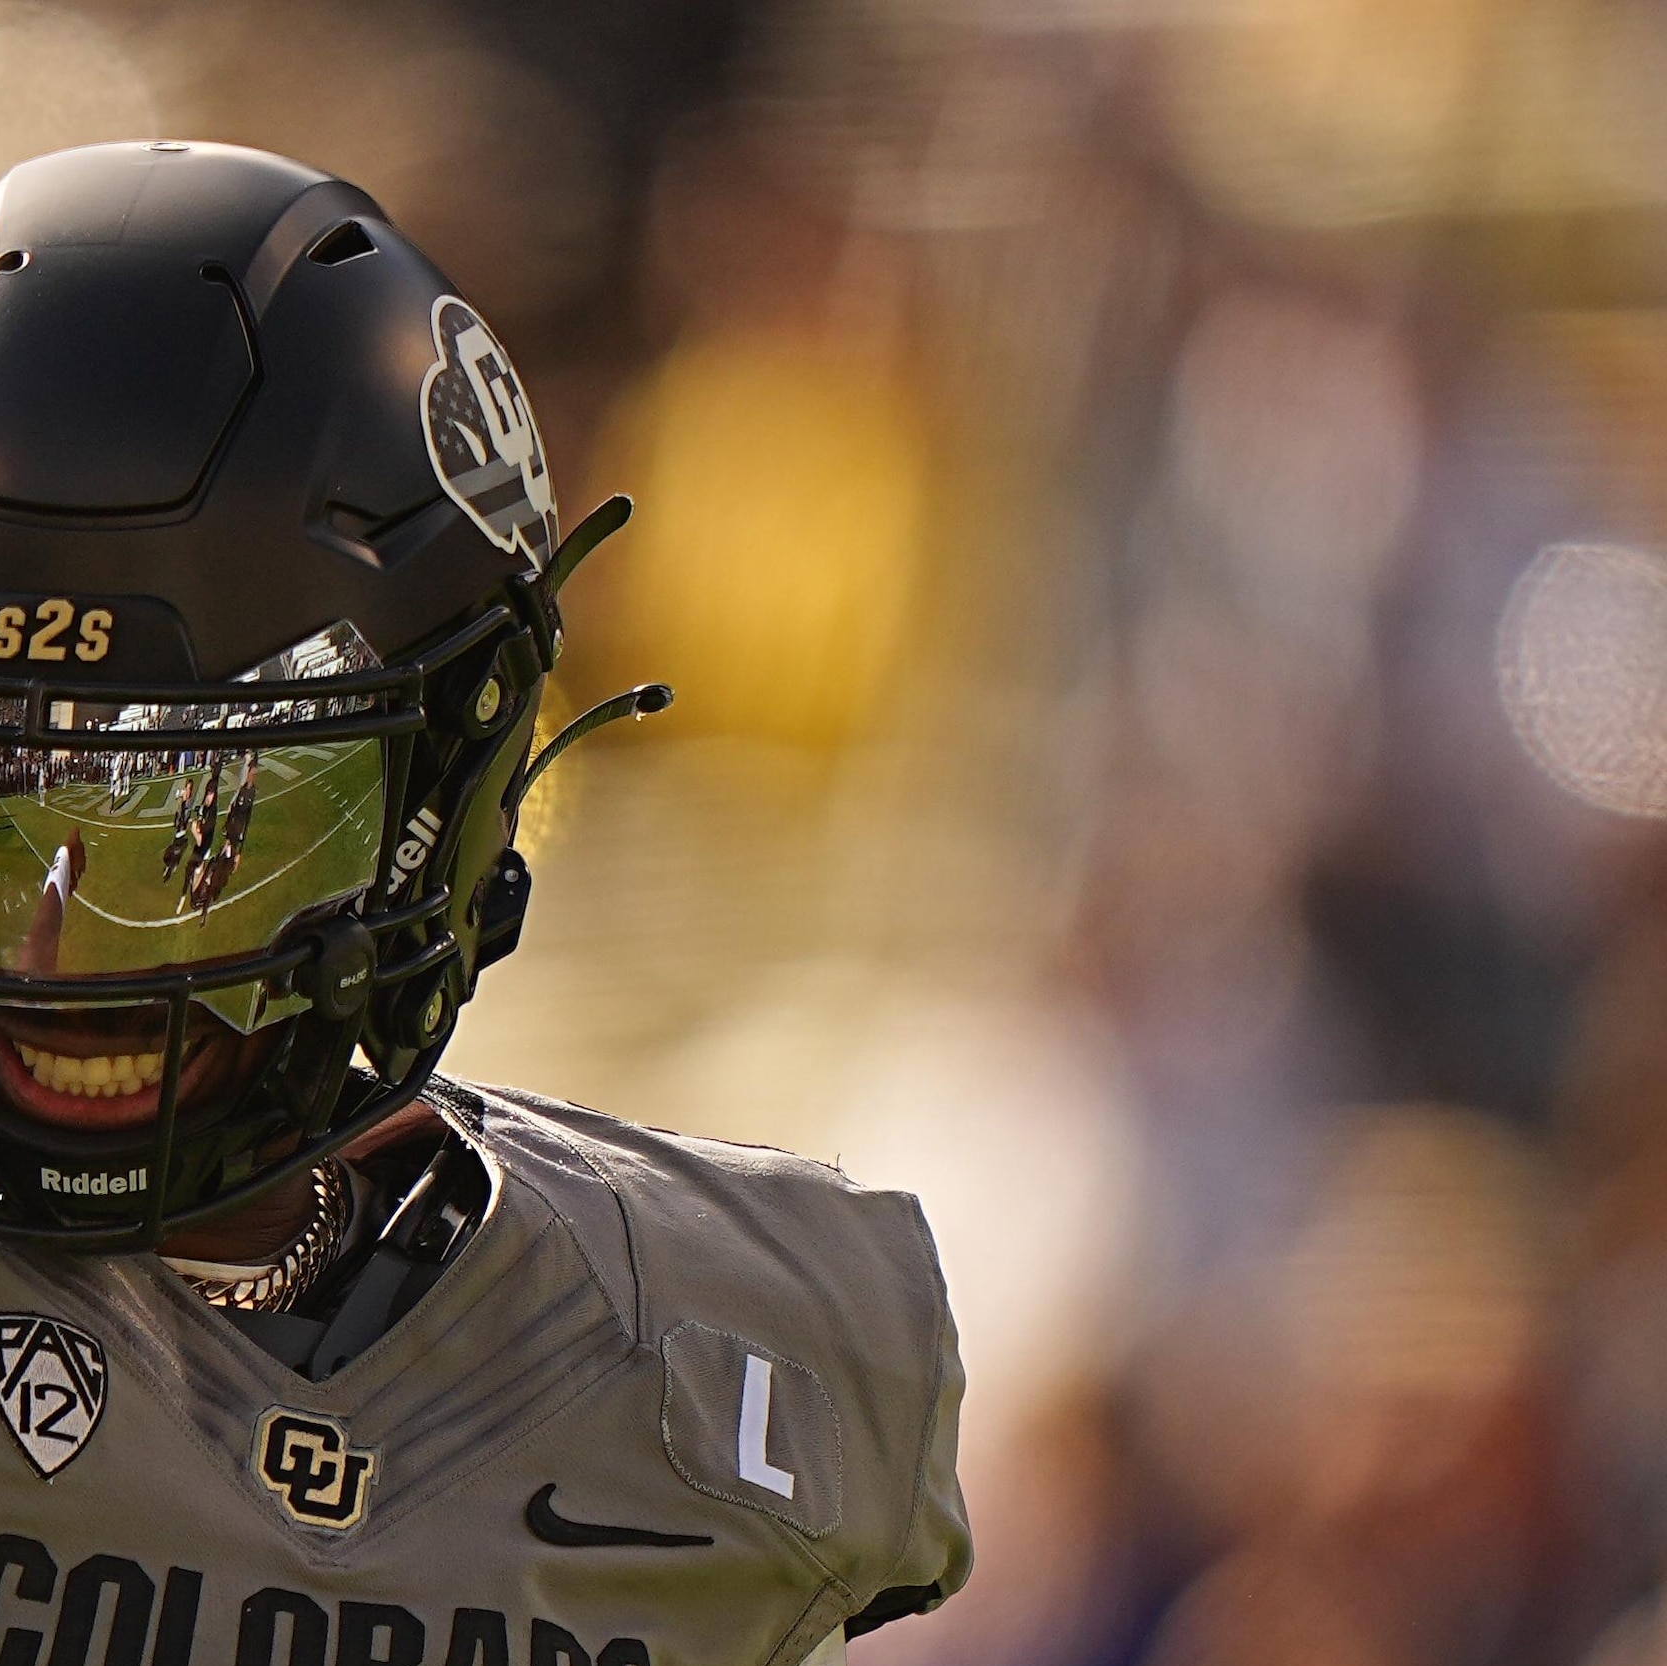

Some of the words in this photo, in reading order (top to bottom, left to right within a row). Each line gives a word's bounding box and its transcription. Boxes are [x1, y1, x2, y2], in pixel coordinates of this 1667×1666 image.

[41, 1167, 147, 1195] Riddell
[20, 1381, 78, 1444] 12
[738, 1353, 795, 1501] L
[259, 1410, 373, 1529] CU
